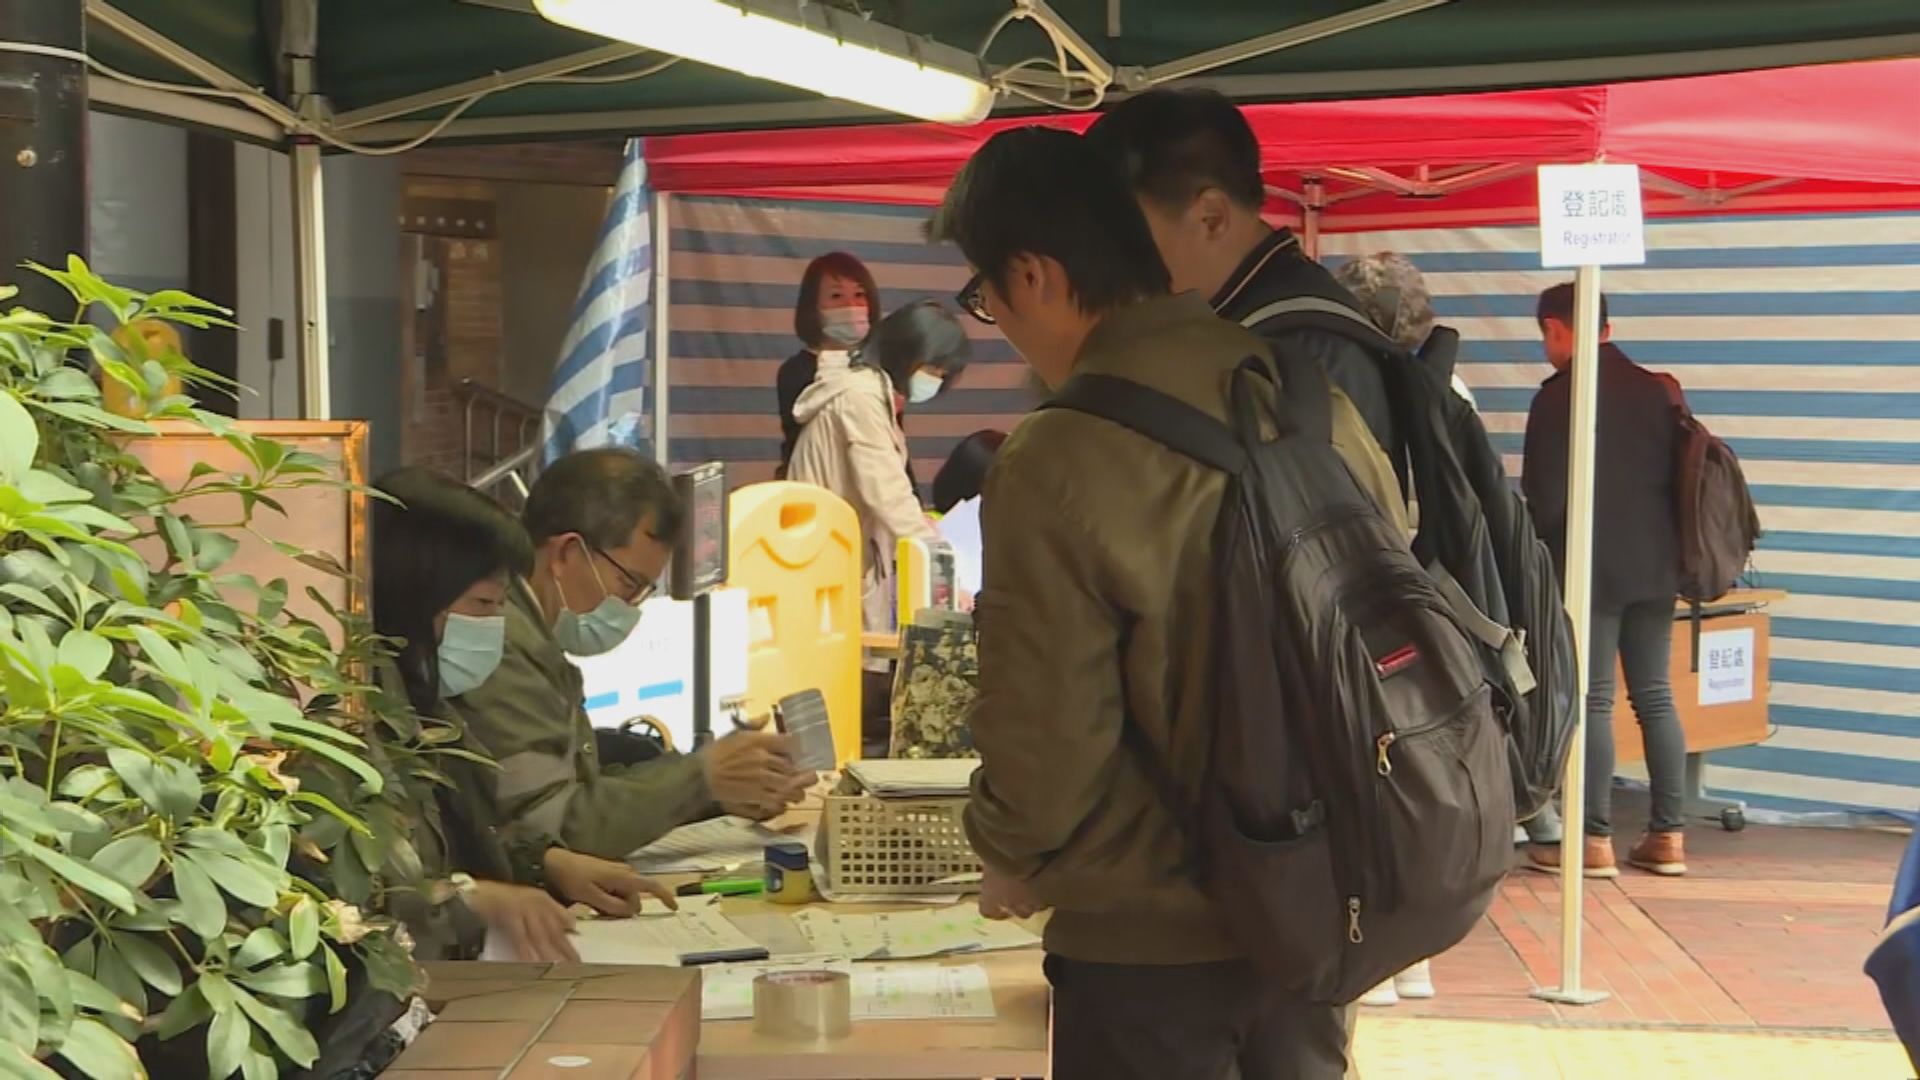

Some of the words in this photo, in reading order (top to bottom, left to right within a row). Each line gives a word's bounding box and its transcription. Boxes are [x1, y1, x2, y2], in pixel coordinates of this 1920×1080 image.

[1561, 189, 1627, 217] 登記處
[1562, 230, 1631, 249] Regstrat
